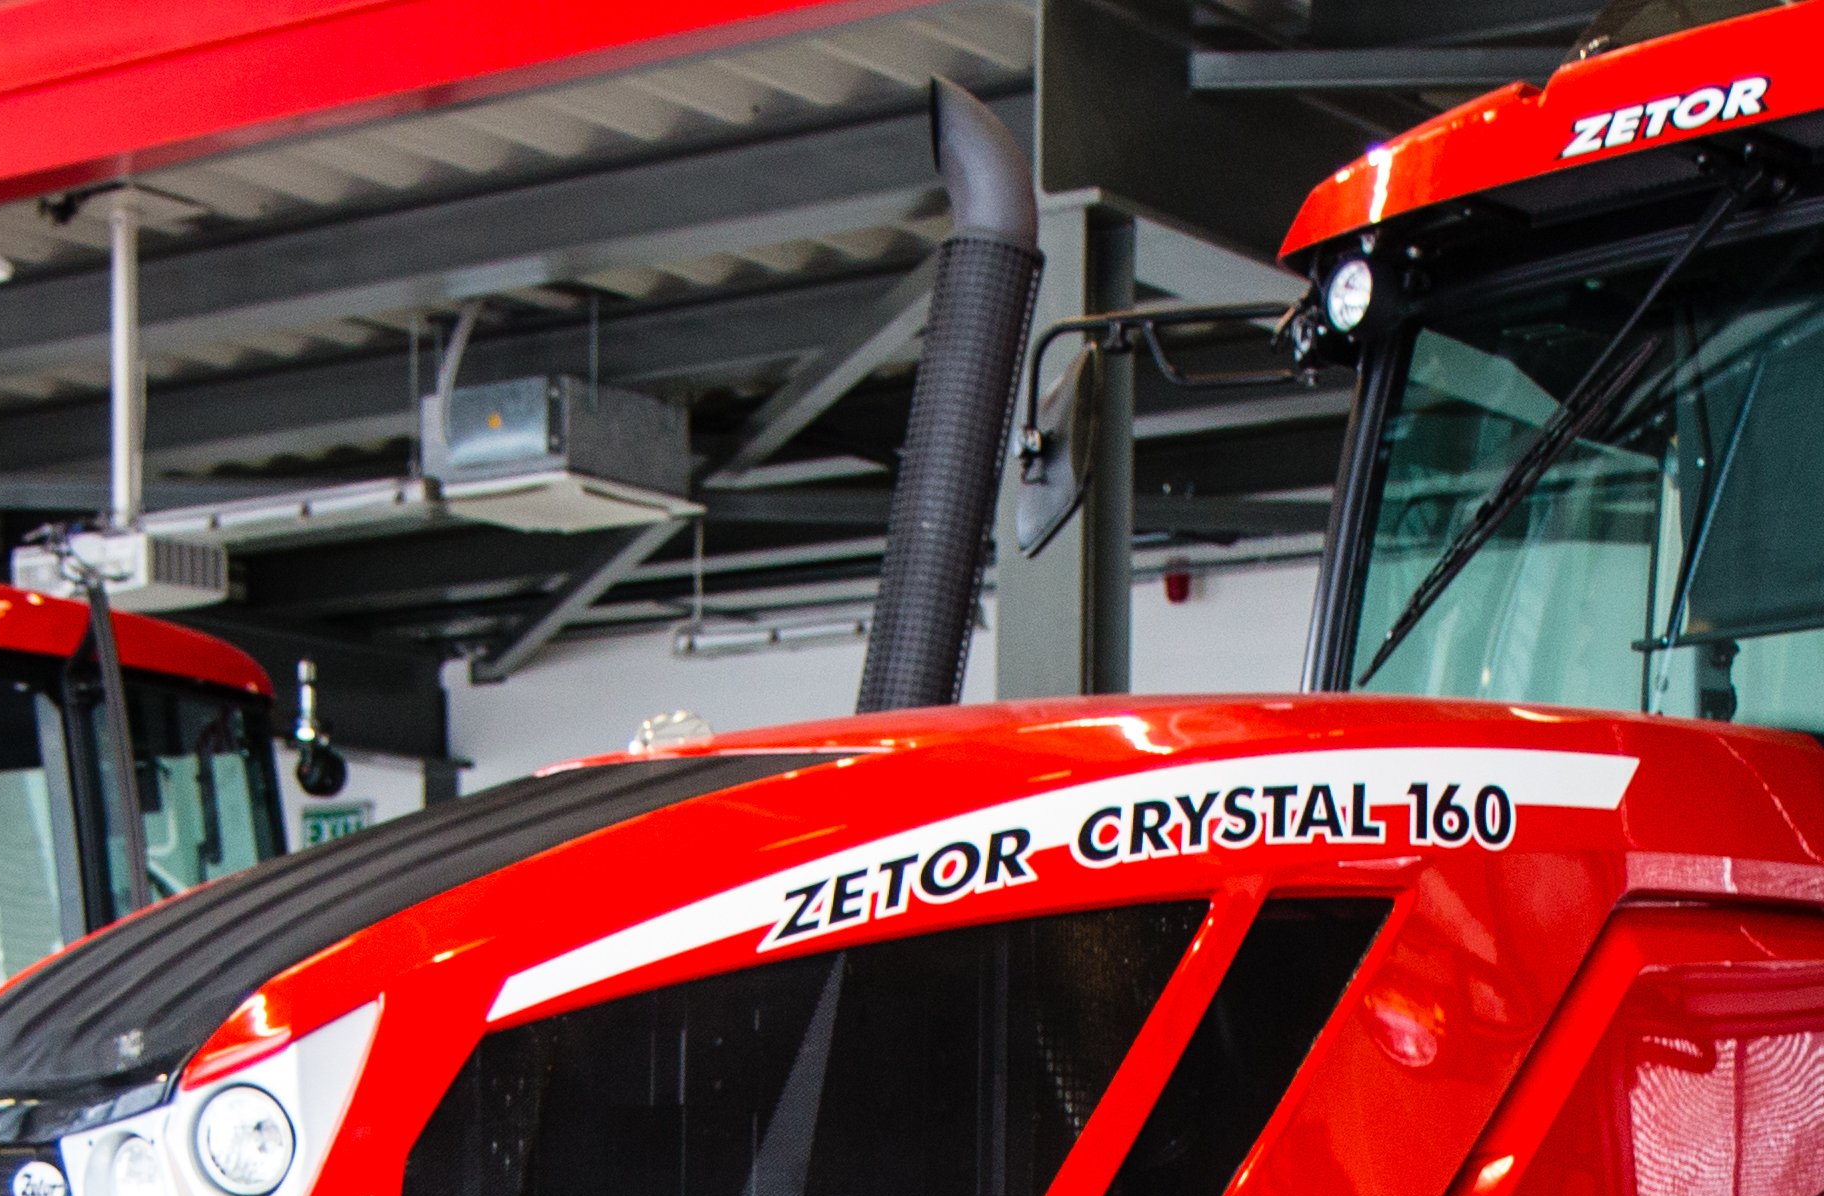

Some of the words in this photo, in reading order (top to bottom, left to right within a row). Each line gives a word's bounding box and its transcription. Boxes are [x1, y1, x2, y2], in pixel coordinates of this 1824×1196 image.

[1558, 75, 1770, 160] ZETOR
[775, 826, 1032, 942] ZETOR
[1076, 783, 1379, 863] CRYSTAL
[1407, 783, 1512, 845] 160
